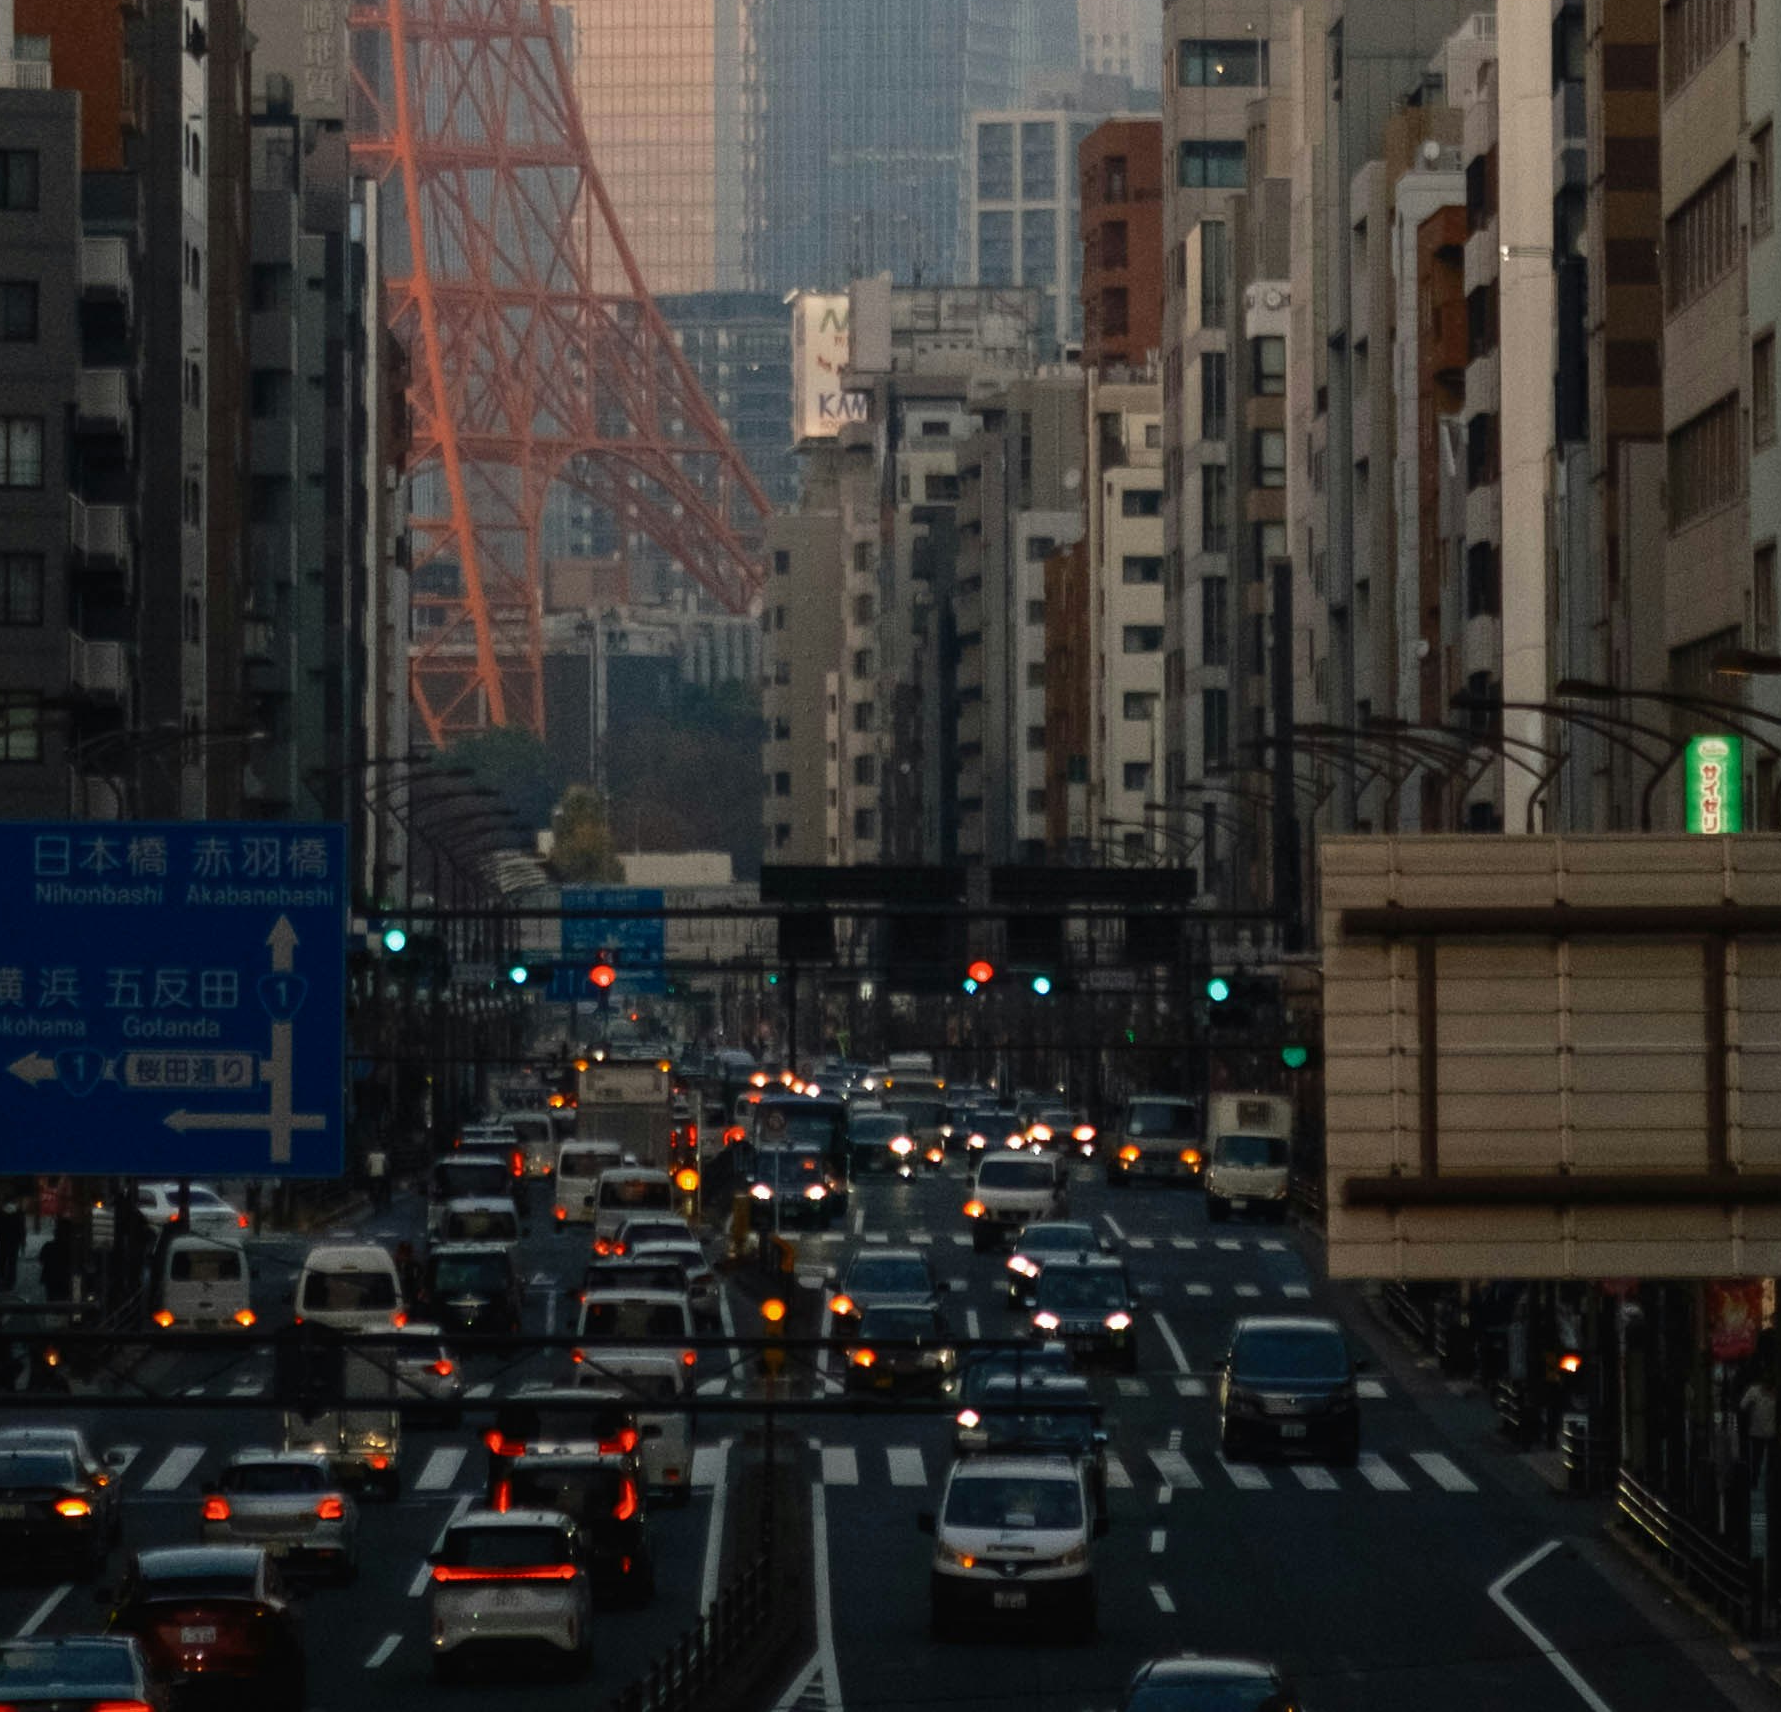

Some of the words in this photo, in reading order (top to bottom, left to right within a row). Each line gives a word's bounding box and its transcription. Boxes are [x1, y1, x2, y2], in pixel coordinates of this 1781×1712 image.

[33, 834, 168, 877] 日本橋
[192, 834, 329, 879] 赤羽橋
[34, 883, 163, 906] Nihonbashi
[185, 883, 335, 908] Akabanebashi
[103, 968, 238, 1009] 五反田
[274, 980, 288, 1007] 1
[121, 1014, 221, 1040] Gotanda
[73, 1055, 86, 1081] 1
[136, 1057, 245, 1085] 桜田通り
